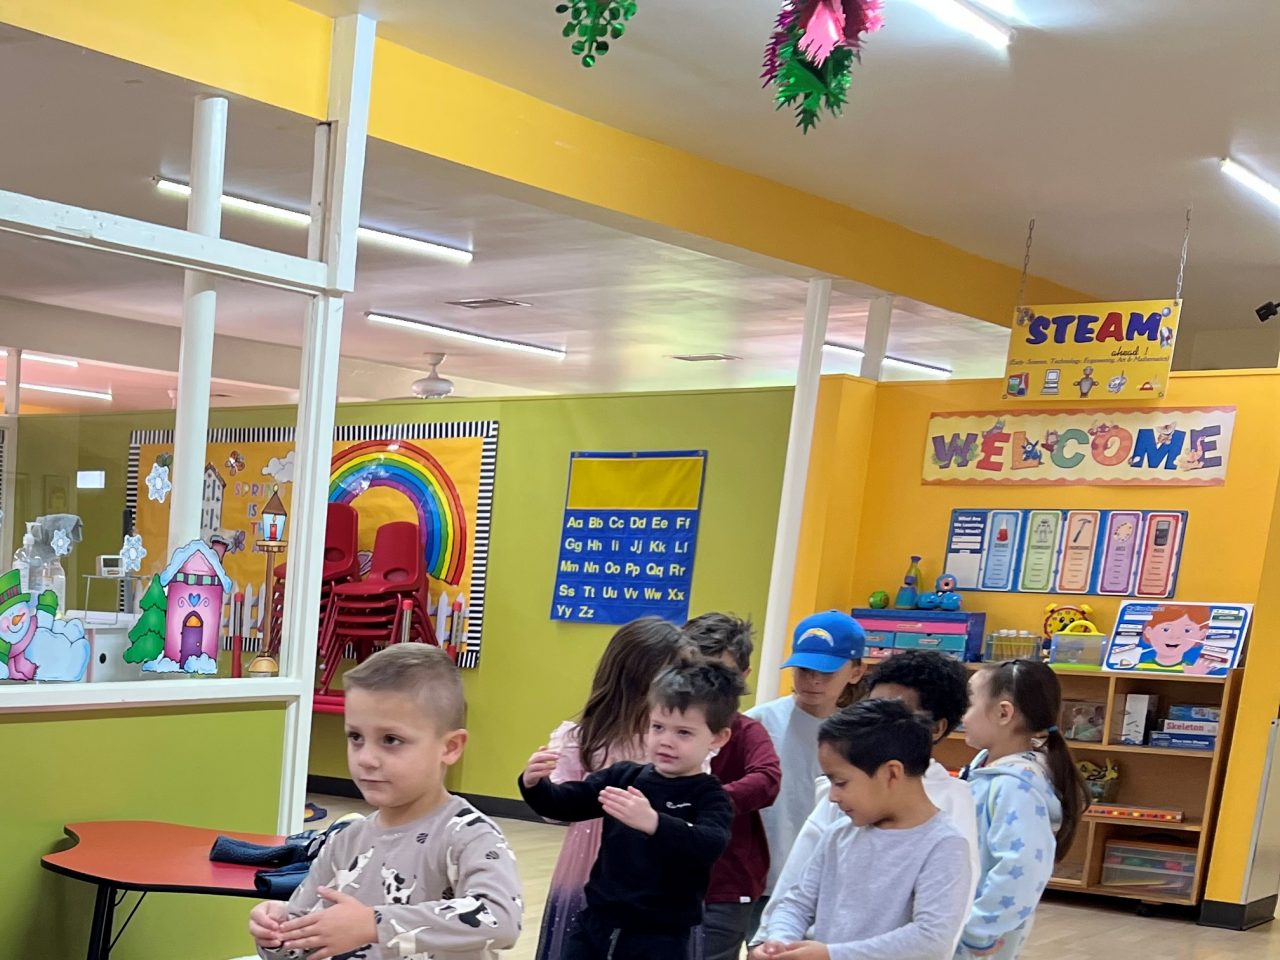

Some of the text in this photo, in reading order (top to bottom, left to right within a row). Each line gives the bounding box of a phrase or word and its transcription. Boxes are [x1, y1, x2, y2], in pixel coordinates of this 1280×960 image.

[1026, 312, 1161, 344] STEAM
[932, 425, 1222, 471] WELCOME
[567, 517, 583, 528] Aa
[589, 517, 603, 528] Bb
[609, 517, 624, 528] Cc
[630, 517, 647, 528] Dd
[652, 517, 668, 528] Ee
[565, 539, 582, 552] Gg
[588, 540, 602, 550] Hh
[631, 540, 642, 554] Jj
[650, 541, 665, 552] Kk
[561, 561, 686, 577] Mm Nn Oo Pp Qq Rr
[560, 585, 684, 600] Ss Tt Uu Vv Ww Xx
[557, 605, 594, 618] Yy Zz
[1166, 722, 1204, 732] Skeleton
